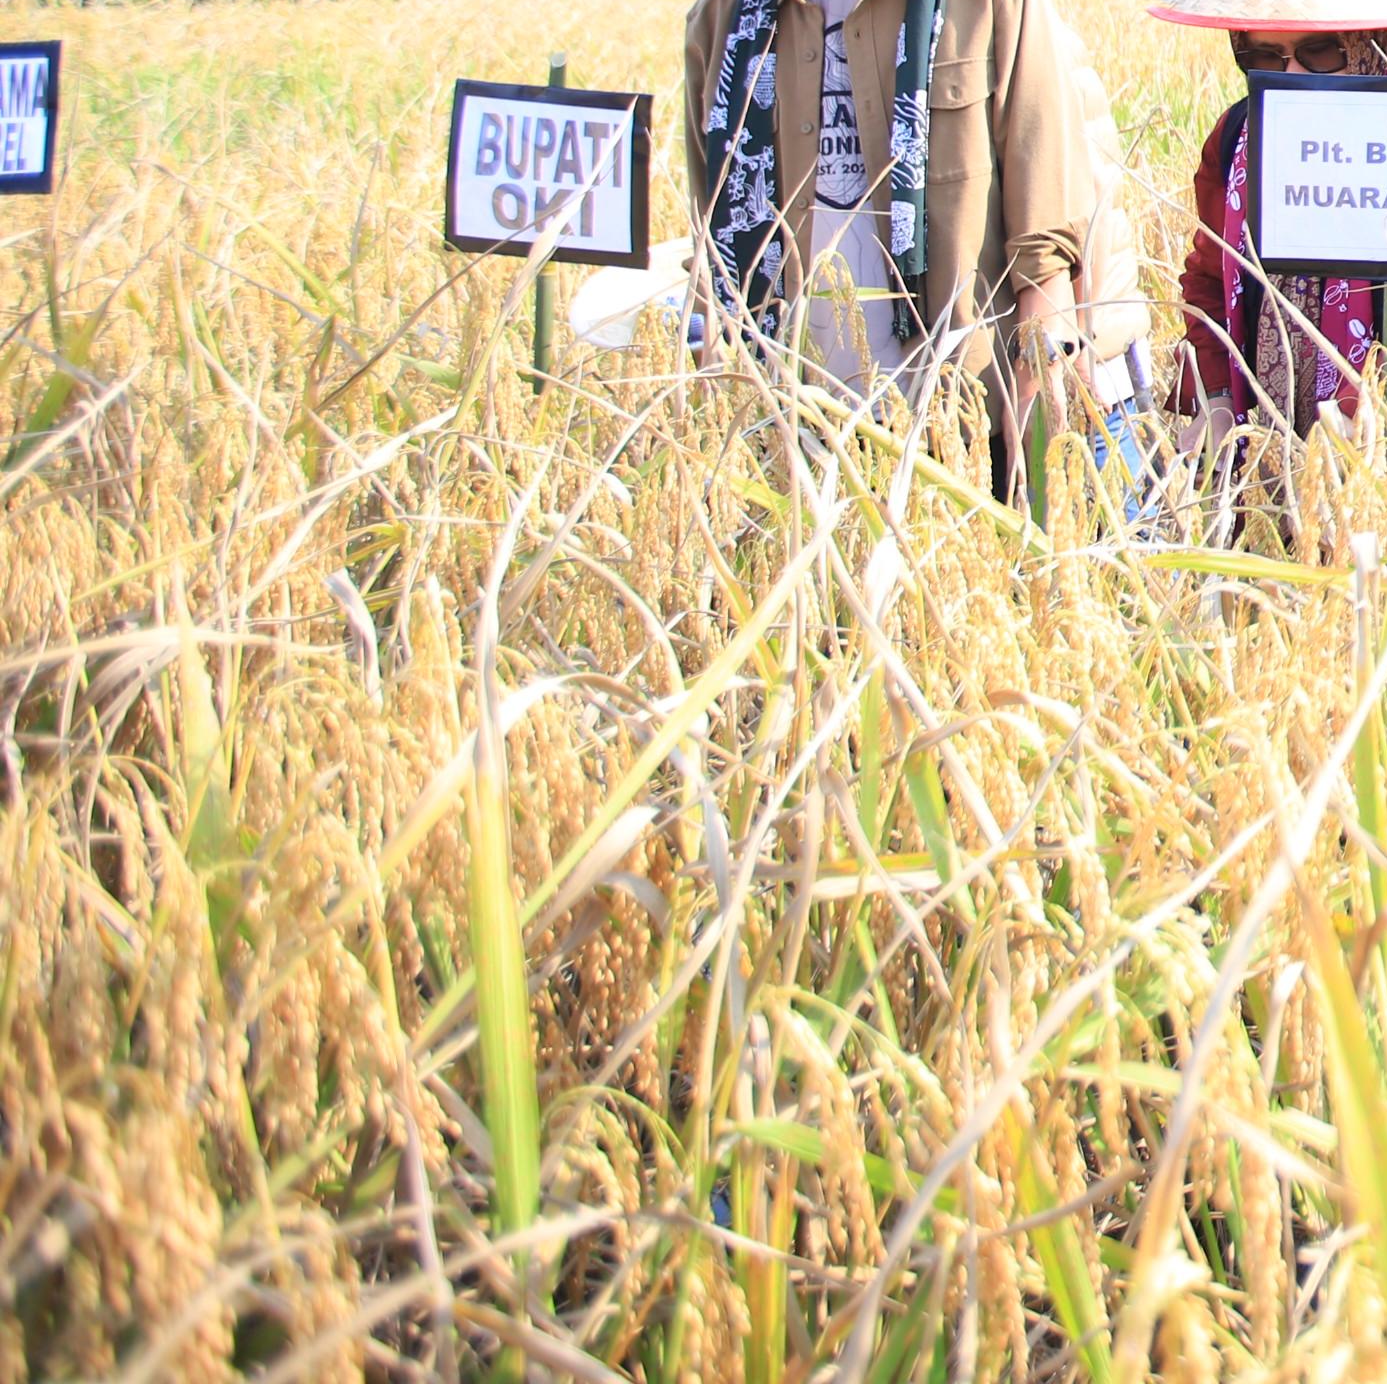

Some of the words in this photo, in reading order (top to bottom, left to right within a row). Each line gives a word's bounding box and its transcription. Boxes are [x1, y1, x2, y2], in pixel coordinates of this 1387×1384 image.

[475, 112, 623, 188] BUPATI
[1300, 140, 1352, 163] Plt.
[492, 183, 593, 237] OKI
